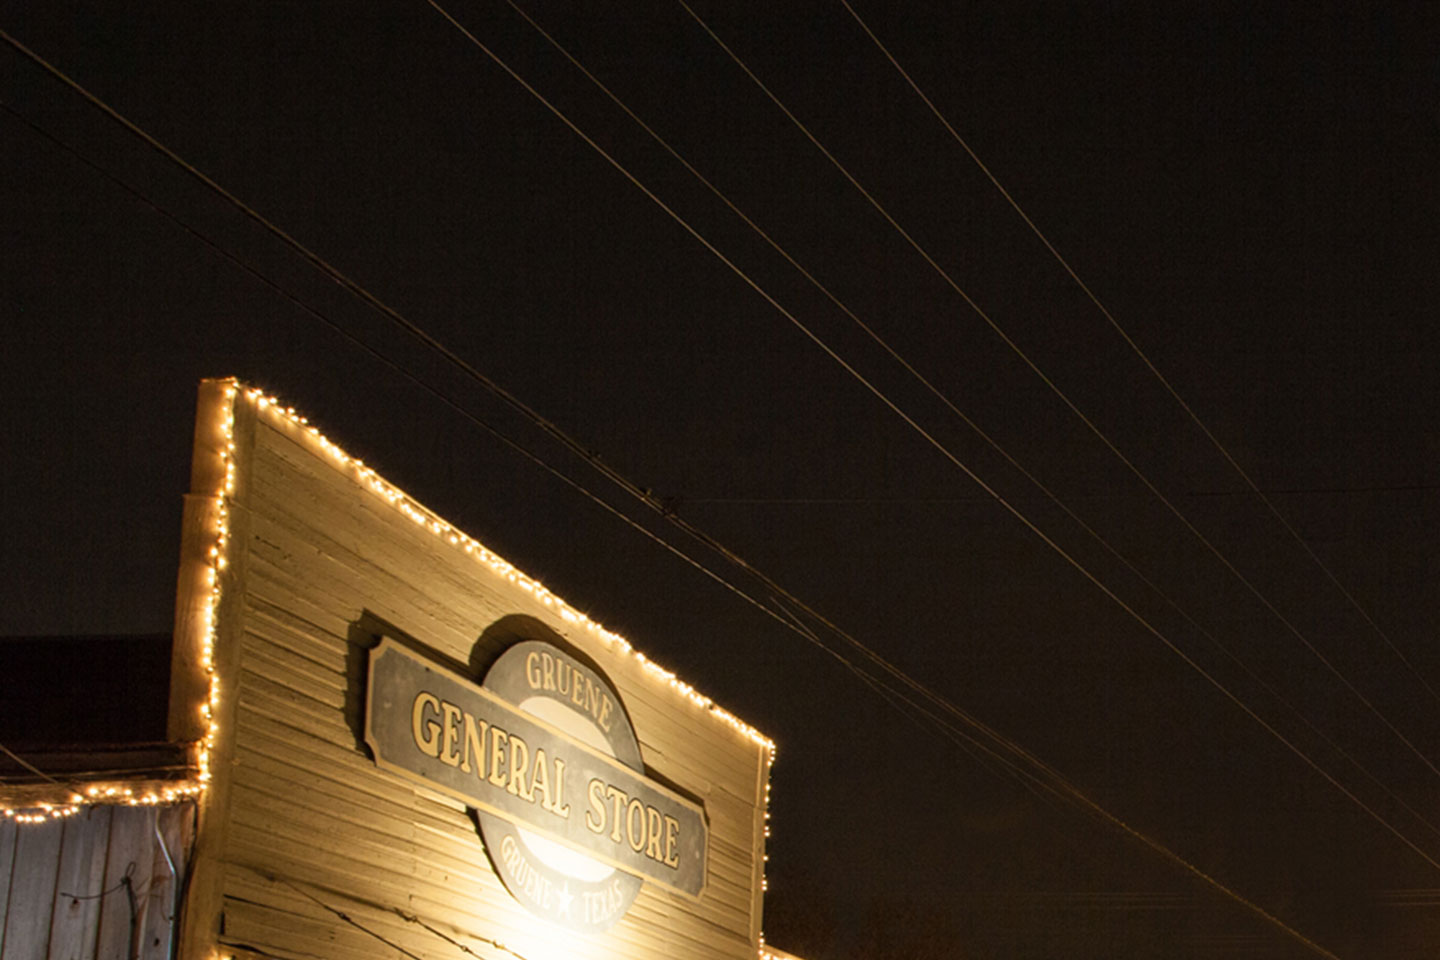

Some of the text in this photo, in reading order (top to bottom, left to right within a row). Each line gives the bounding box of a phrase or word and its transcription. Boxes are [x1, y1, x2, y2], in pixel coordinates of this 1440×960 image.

[526, 651, 615, 732] GRUENE
[411, 690, 681, 869] GENERAL STORE
[500, 834, 624, 925] GRUENE TEXAS
